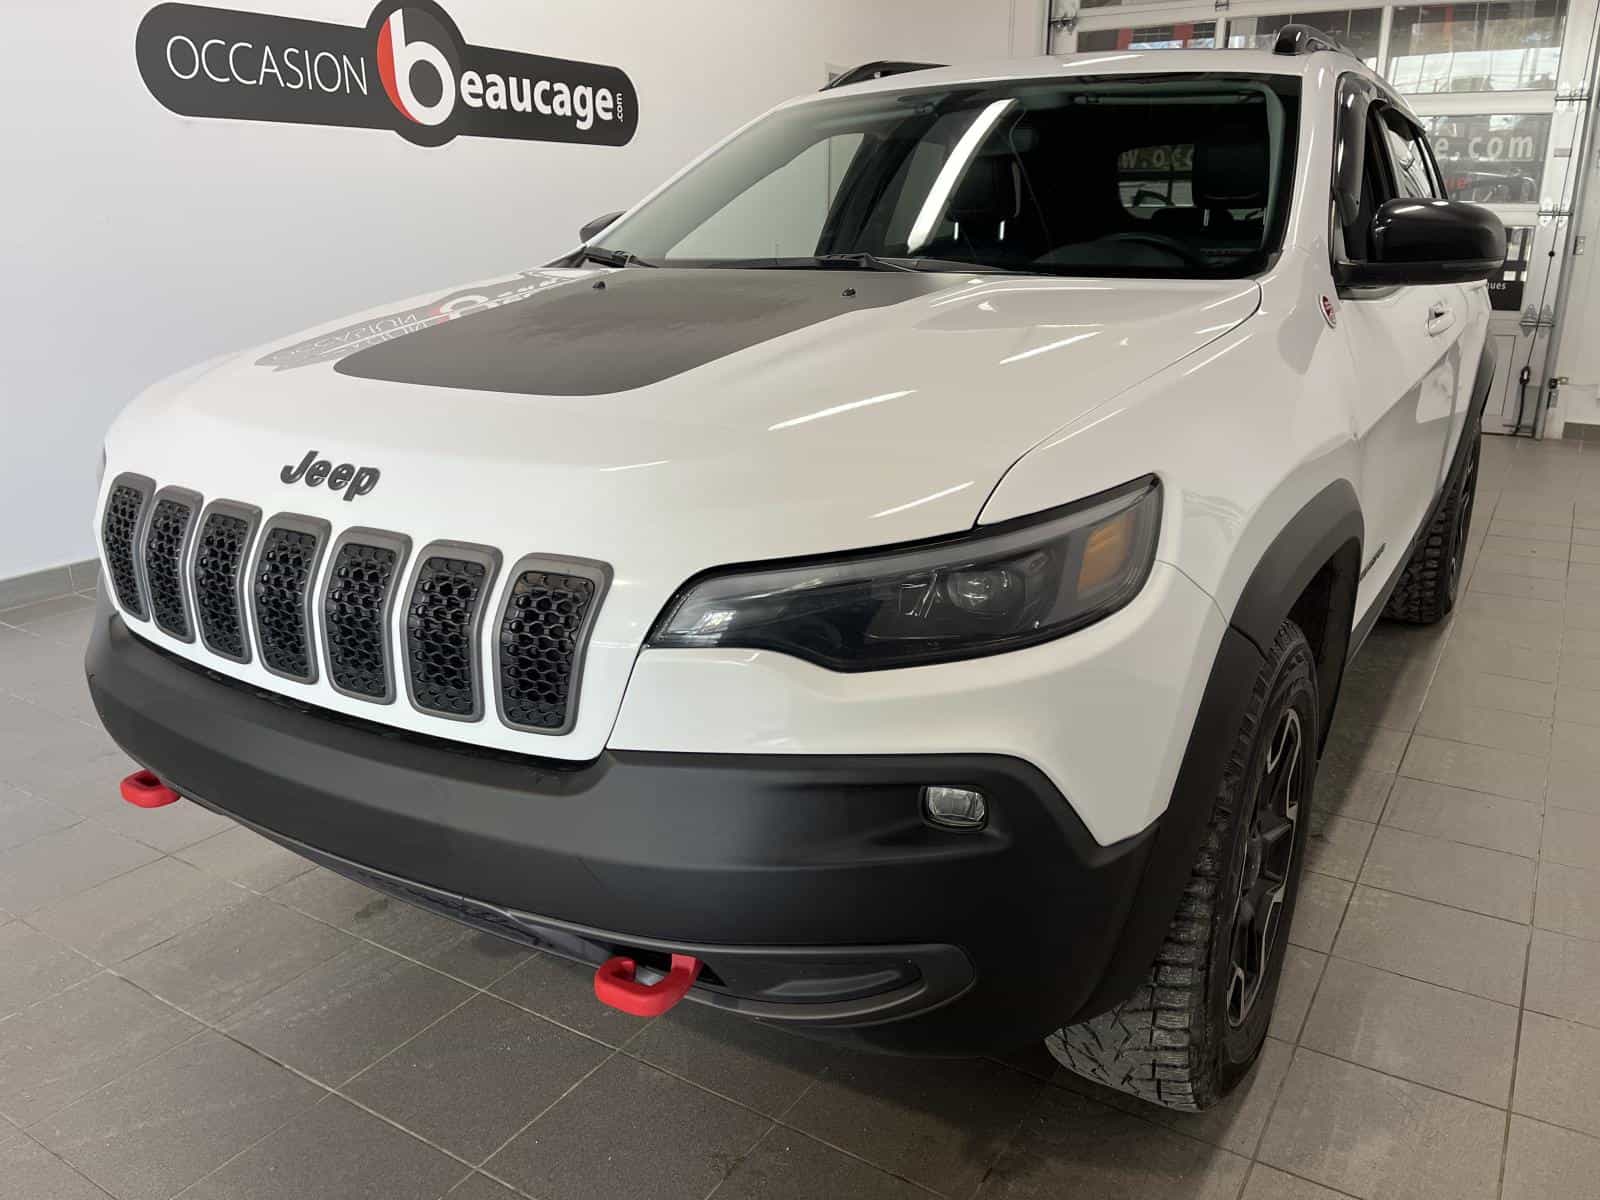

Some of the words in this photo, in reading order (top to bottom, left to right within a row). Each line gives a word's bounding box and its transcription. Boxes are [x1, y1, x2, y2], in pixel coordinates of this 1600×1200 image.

[166, 35, 368, 96] OCCASION
[390, 8, 614, 130] beaucage
[616, 93, 624, 123] .com
[280, 450, 380, 502] Jeep
